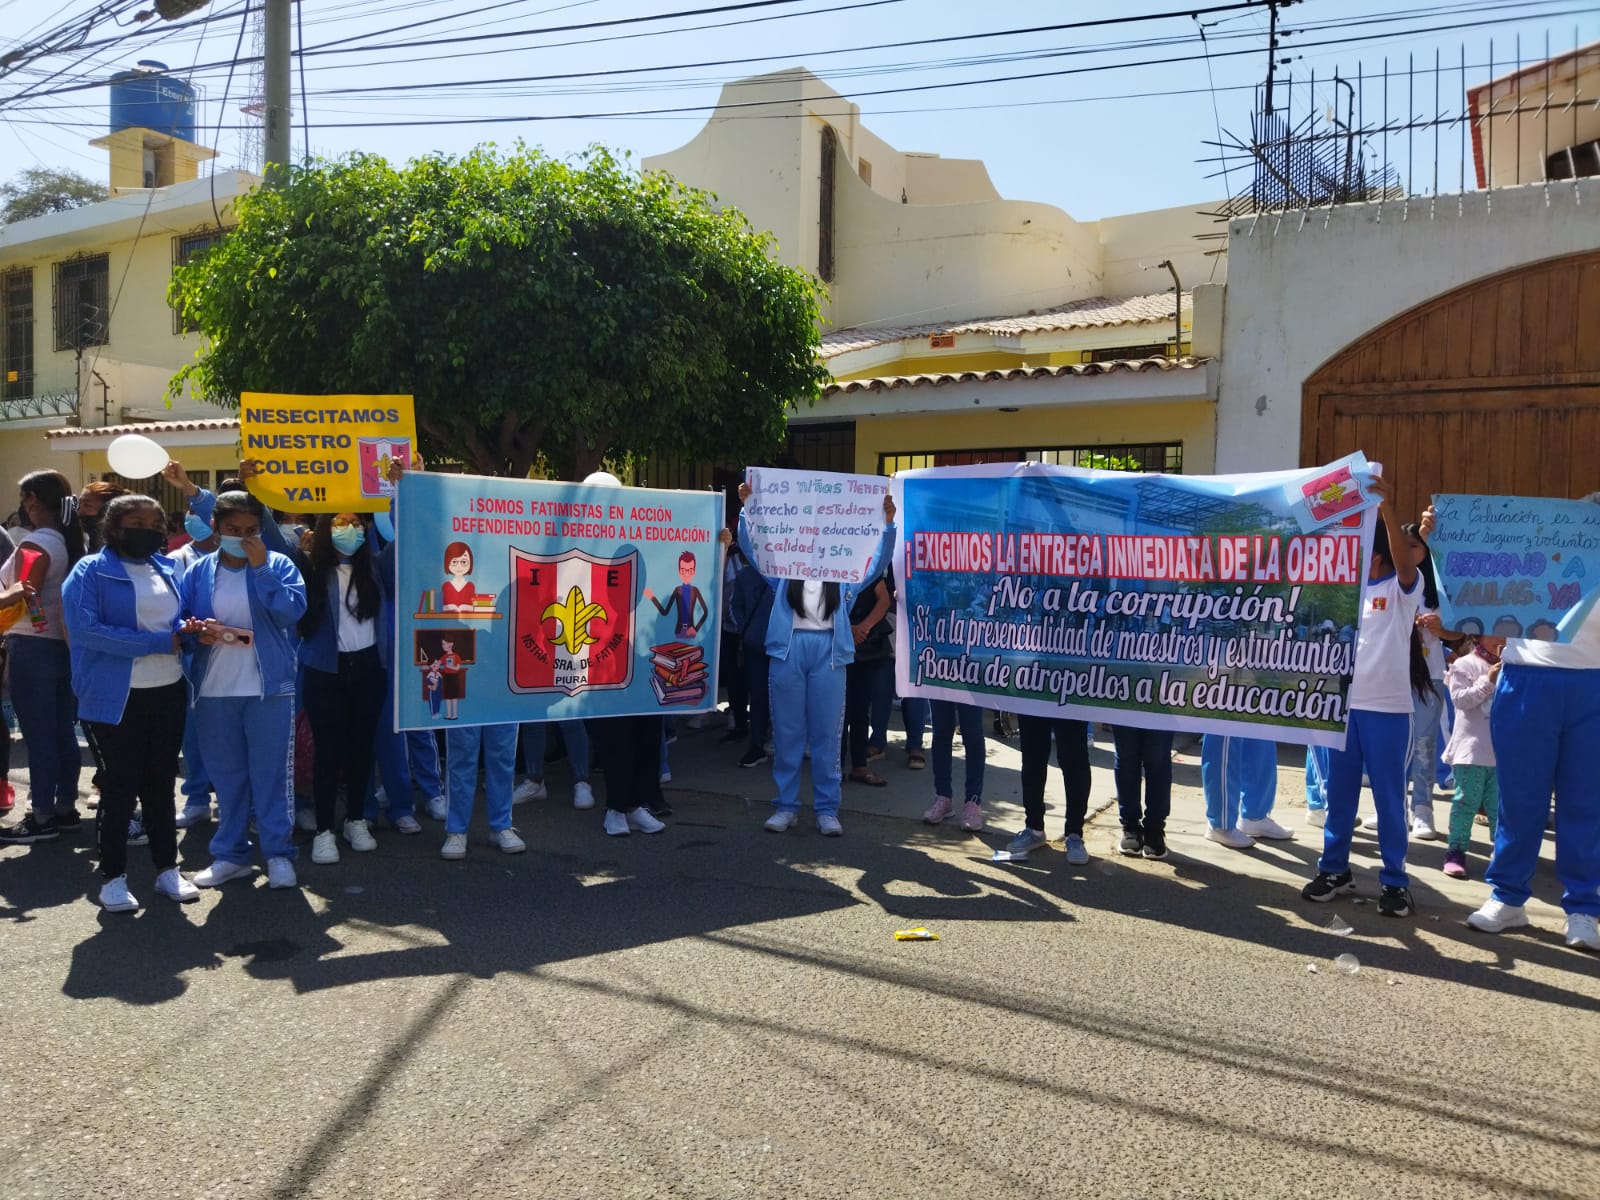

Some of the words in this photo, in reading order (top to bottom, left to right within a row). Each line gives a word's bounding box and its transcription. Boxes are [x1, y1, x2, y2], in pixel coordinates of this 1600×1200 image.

[246, 408, 399, 424] NESECITAMOS
[248, 434, 351, 449] NUESTRO
[253, 459, 348, 474] COLEGIO
[284, 487, 326, 502] YA!!
[531, 501, 602, 519] FATIMISTAS
[609, 506, 624, 520] EN
[630, 505, 672, 522] ACCIÓN
[749, 499, 798, 516] derecho
[452, 517, 541, 536] DEFENDIENDO
[544, 522, 558, 537] EL
[562, 522, 618, 540] DERECHO
[619, 524, 628, 540] A
[629, 526, 643, 541] LA
[645, 526, 711, 543] EDUCACIÓN!
[756, 520, 795, 534] recibir
[822, 521, 880, 536] educación
[764, 537, 815, 554] calidad
[818, 546, 826, 559] y
[830, 544, 853, 556] sin
[996, 533, 1016, 574] LA
[1018, 534, 1104, 578] ENTREGA
[1106, 535, 1216, 582] INMEDIATA
[1218, 536, 1250, 582] DE
[1252, 536, 1282, 582] LA
[1286, 536, 1361, 584] OBRA!
[1445, 552, 1547, 578] RETORNO
[1562, 555, 1586, 578] A
[530, 568, 540, 586] I
[607, 570, 618, 587] E
[988, 575, 1036, 616] ¡No
[1042, 586, 1063, 612] a
[1067, 581, 1098, 614] la
[1106, 584, 1303, 630] corrupción!
[1455, 579, 1534, 607] AULAS
[936, 617, 946, 644] a
[948, 610, 965, 645] la
[966, 614, 1088, 656] presencialidad
[1091, 618, 1114, 659] de
[1117, 626, 1204, 666] maestros
[1206, 635, 1222, 680] y
[553, 658, 576, 671] SRA.
[581, 658, 594, 670] DE
[556, 676, 588, 684] PIURA
[916, 646, 980, 686] ¡Basta
[984, 654, 1010, 688] de
[1015, 660, 1130, 706] atropellos
[1135, 678, 1153, 704] a
[1158, 671, 1188, 707] la
